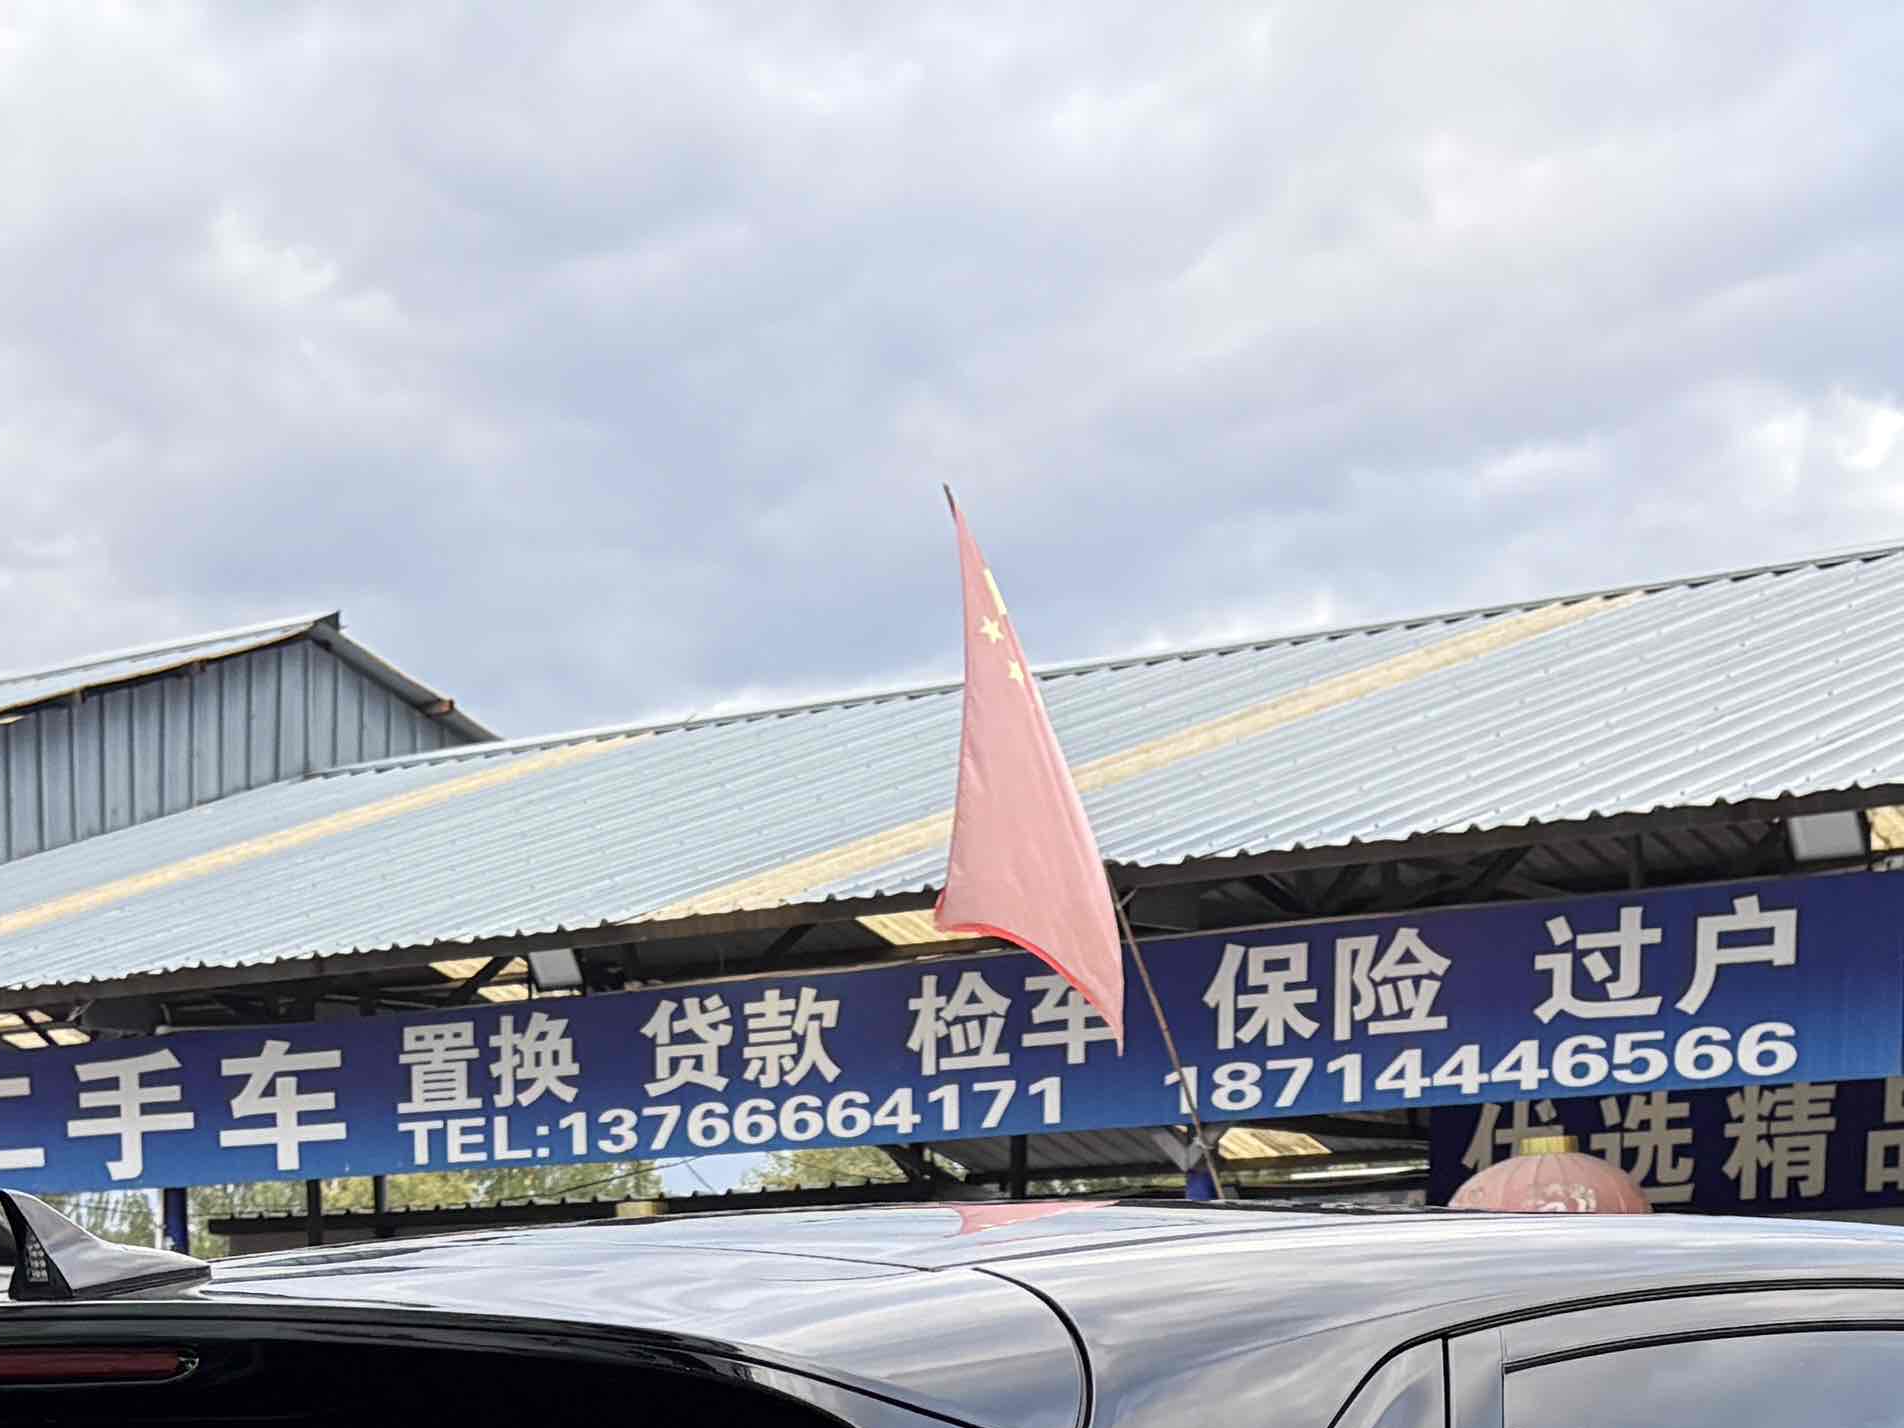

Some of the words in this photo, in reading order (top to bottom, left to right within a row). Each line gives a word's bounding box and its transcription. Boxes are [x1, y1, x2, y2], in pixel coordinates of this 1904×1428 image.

[1201, 926, 1452, 1050] 保险
[1533, 896, 1799, 1024] 过户
[398, 1011, 581, 1116] 置换
[641, 986, 842, 1097] 贷款
[906, 971, 1120, 1075] 检车
[1164, 1021, 1799, 1115] 18714446566
[398, 1076, 1063, 1167] TEL:13766664171
